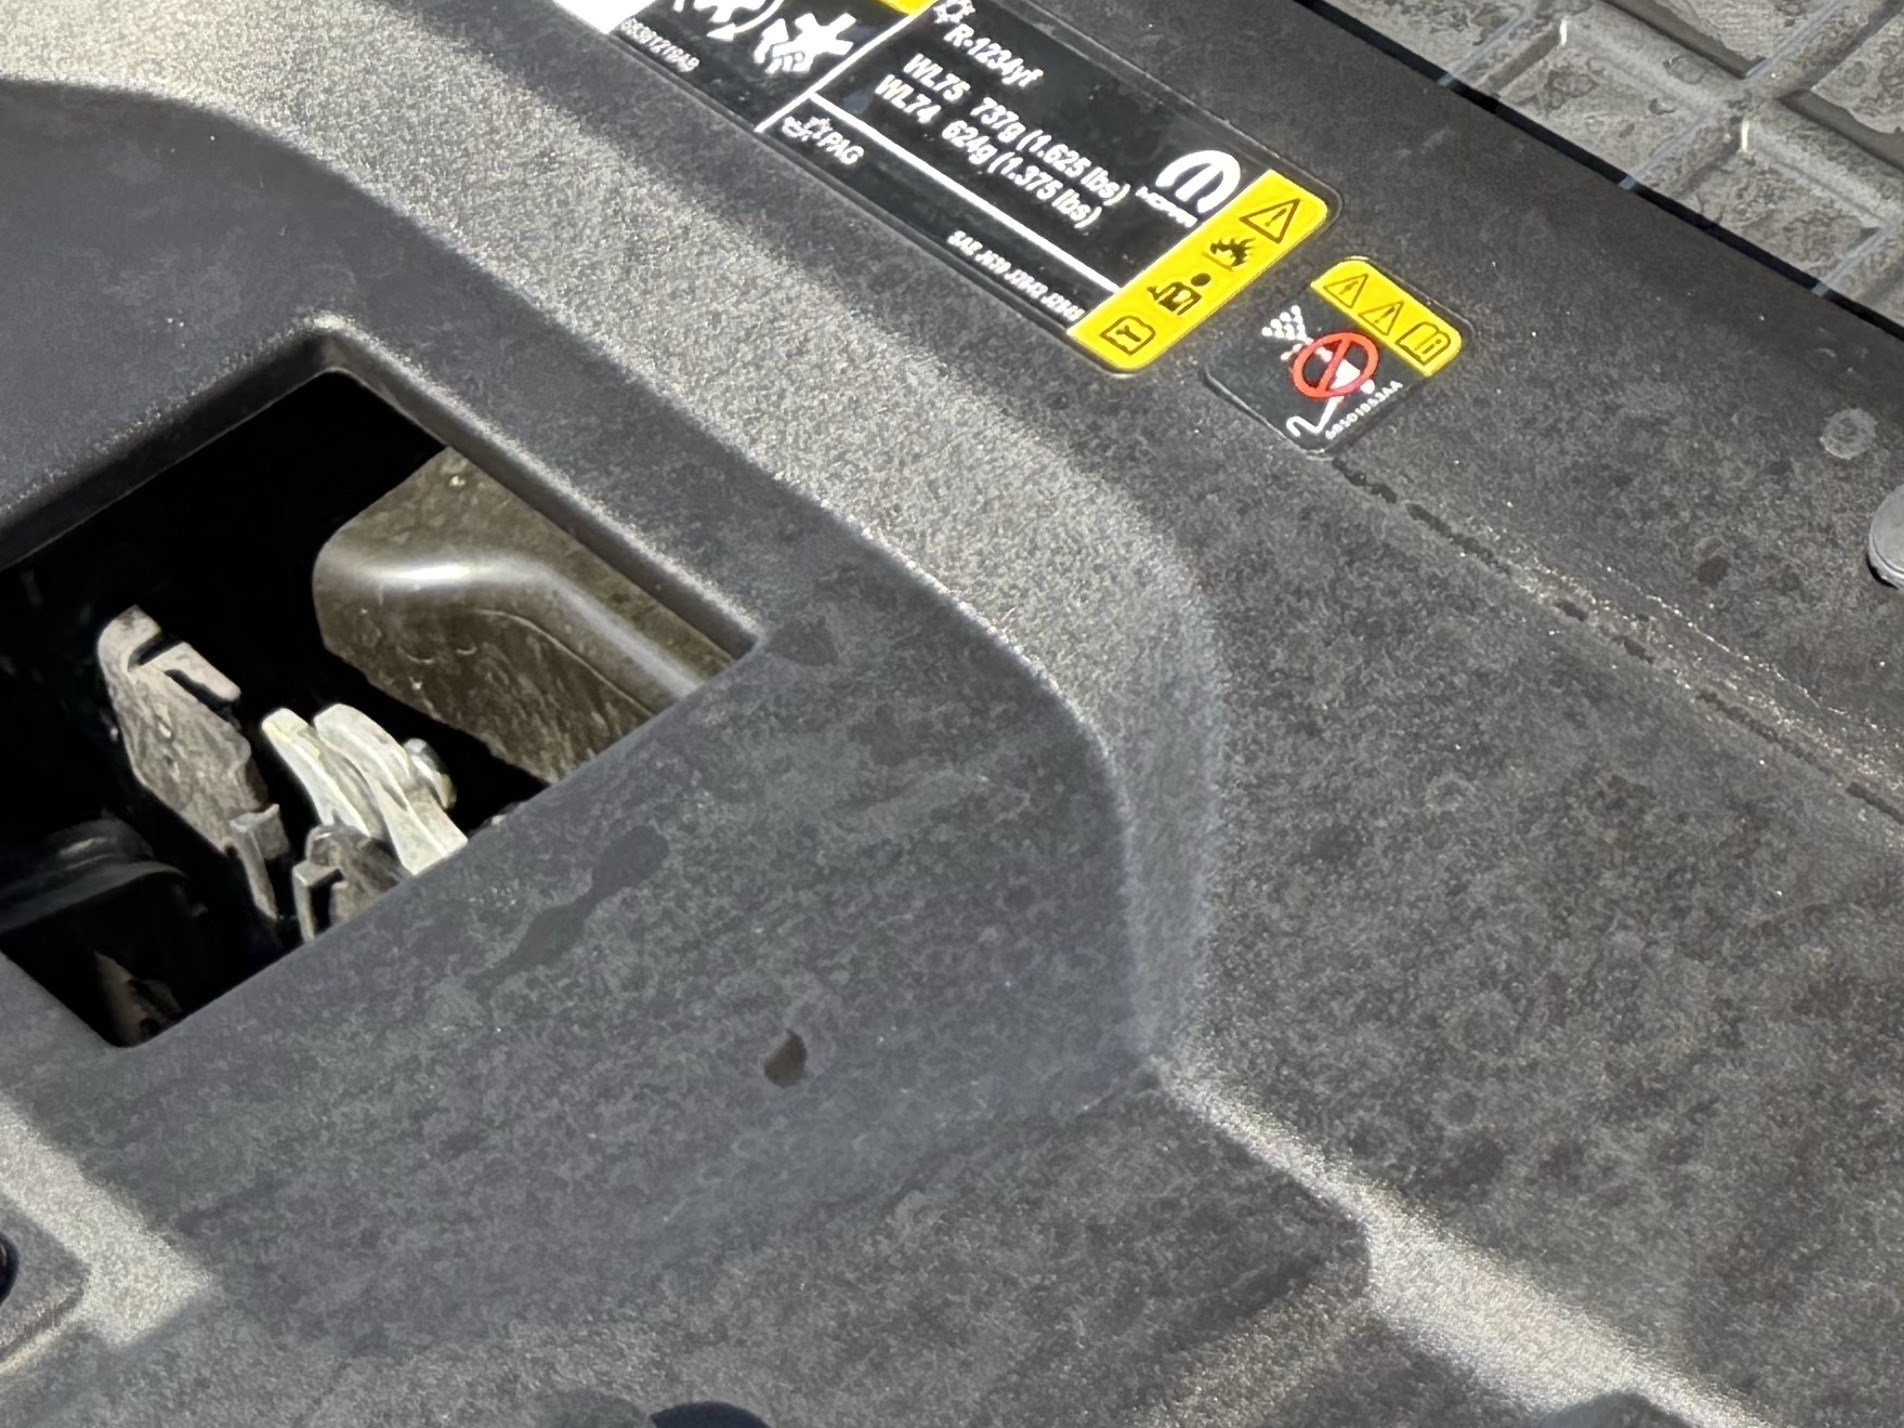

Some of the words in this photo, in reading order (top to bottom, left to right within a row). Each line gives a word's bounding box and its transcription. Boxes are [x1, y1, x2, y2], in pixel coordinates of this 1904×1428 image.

[943, 23, 1044, 87] R-1234yf
[819, 132, 864, 165] PAG
[874, 74, 941, 124] WL74
[941, 119, 998, 165] 624g
[987, 151, 1064, 200] (1.375
[1052, 189, 1102, 229] lbs)
[903, 53, 971, 102] WL75
[970, 96, 1026, 143] 737g
[1016, 129, 1091, 178] (1.625
[1081, 166, 1130, 206] lbs)
[947, 230, 983, 256] SAE
